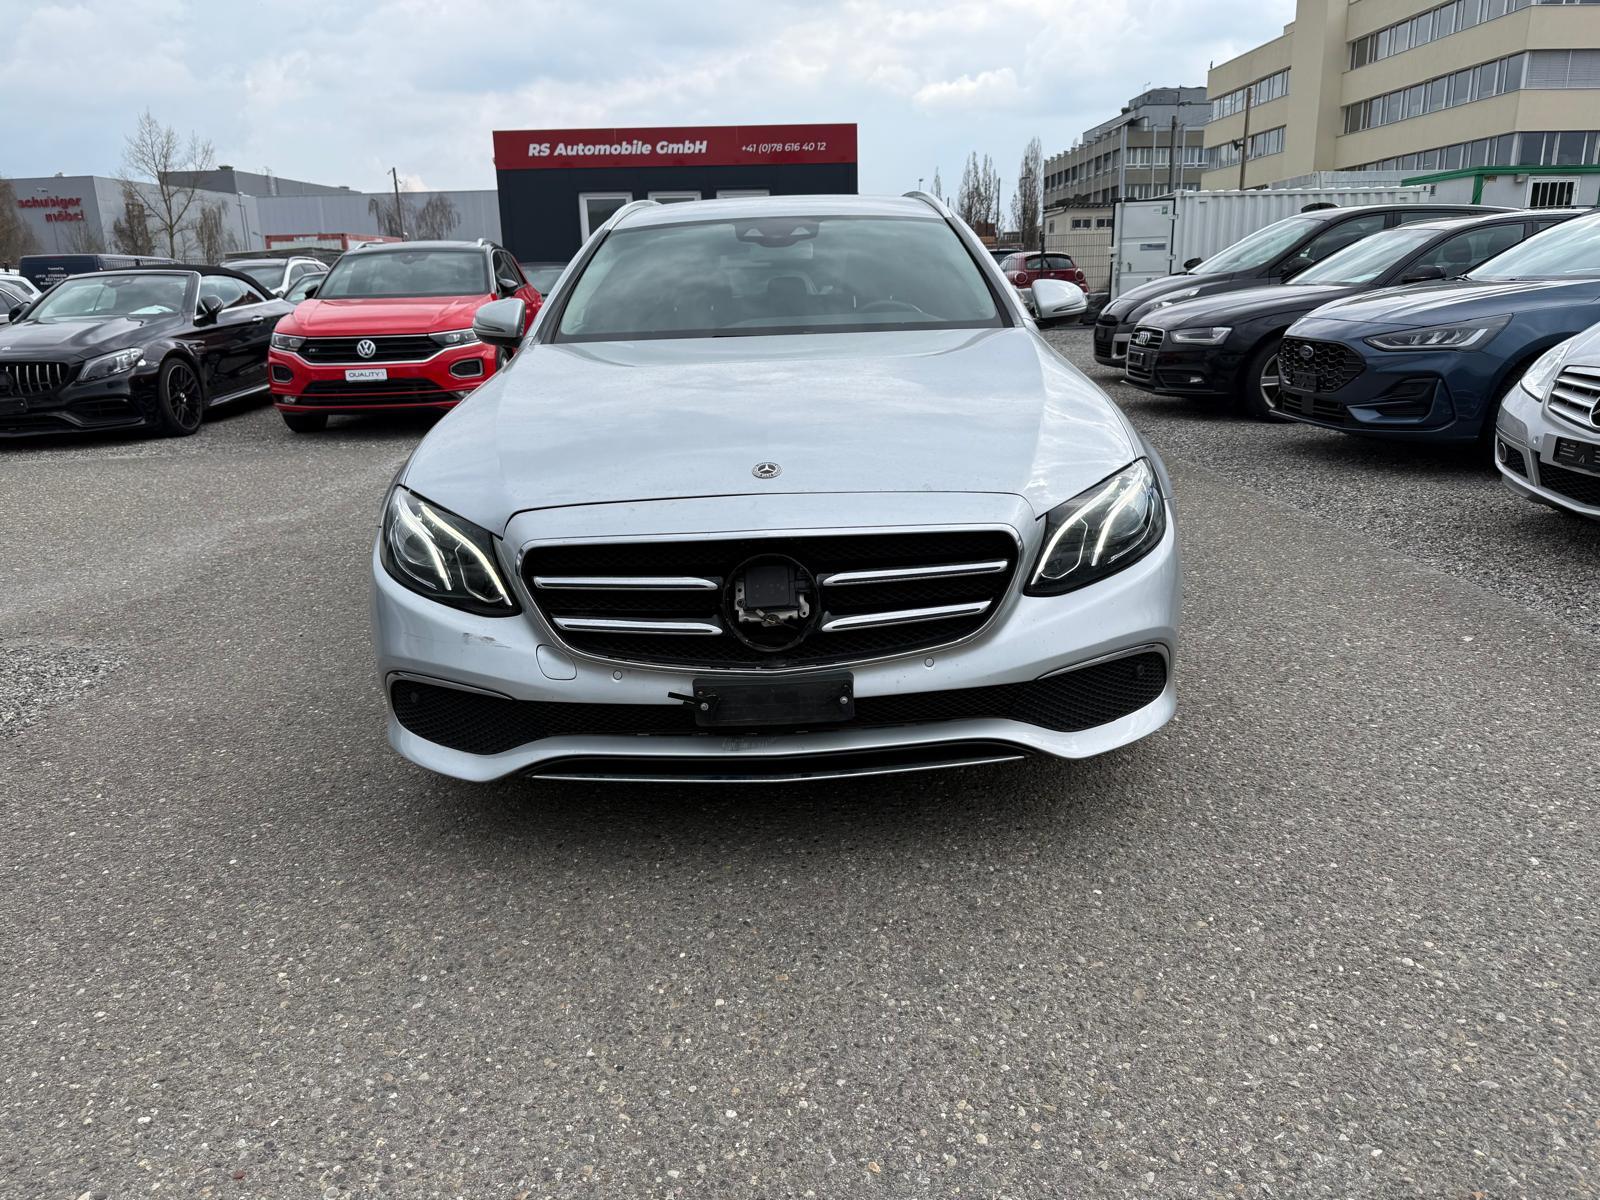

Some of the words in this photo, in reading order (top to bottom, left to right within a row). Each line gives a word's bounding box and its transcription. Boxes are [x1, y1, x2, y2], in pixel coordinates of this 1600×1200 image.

[528, 143, 551, 157] RS
[554, 140, 652, 156] Automobile
[656, 140, 708, 154] GmbH
[741, 144, 756, 152] +41
[759, 143, 782, 154] (0)78
[785, 142, 800, 151] 616
[802, 142, 815, 151] 40
[817, 142, 827, 151] 12
